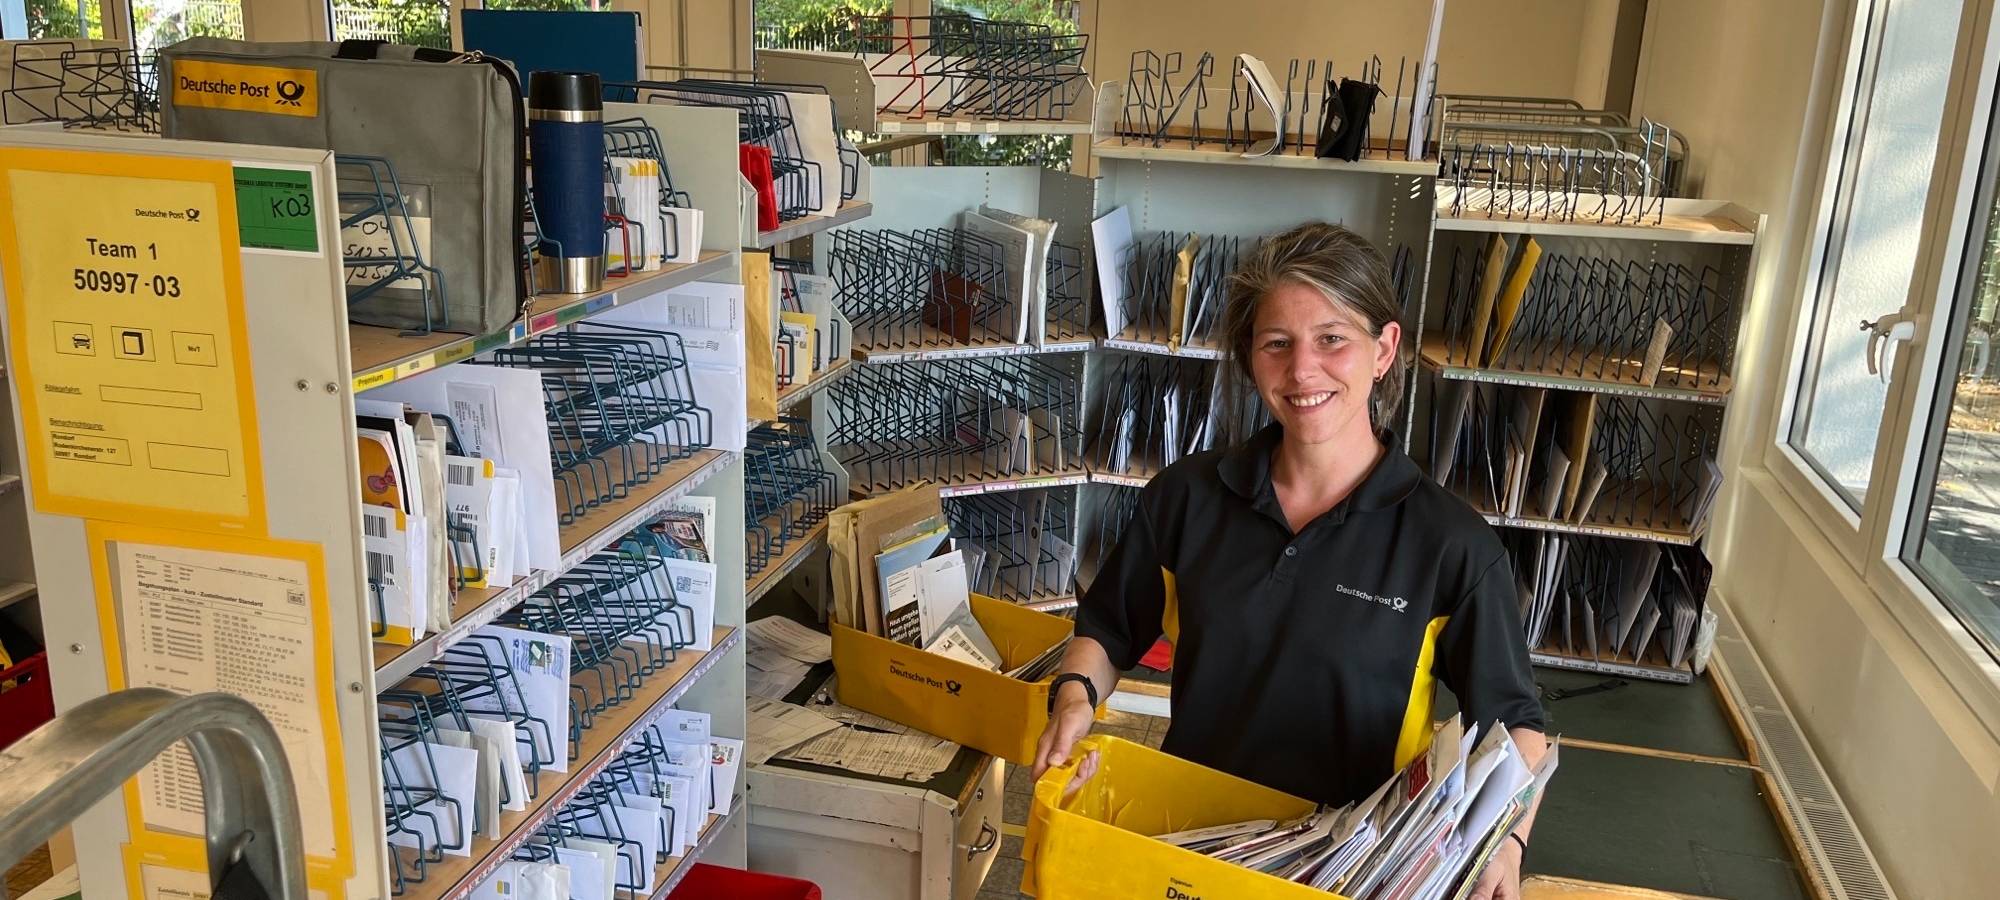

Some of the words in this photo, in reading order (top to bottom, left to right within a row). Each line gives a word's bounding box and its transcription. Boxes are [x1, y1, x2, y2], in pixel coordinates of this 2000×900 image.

[180, 76, 236, 95] Deutsche
[240, 82, 270, 97] Post
[135, 208, 167, 219] Deutsche
[169, 211, 184, 219] Post
[271, 194, 311, 218] K03
[86, 238, 137, 259] Team
[148, 243, 157, 260] 1
[357, 373, 384, 387] Premium
[1336, 584, 1373, 601] Deutsche
[1374, 595, 1391, 606] Post
[889, 665, 925, 683] Deutsche
[926, 677, 943, 688] Post
